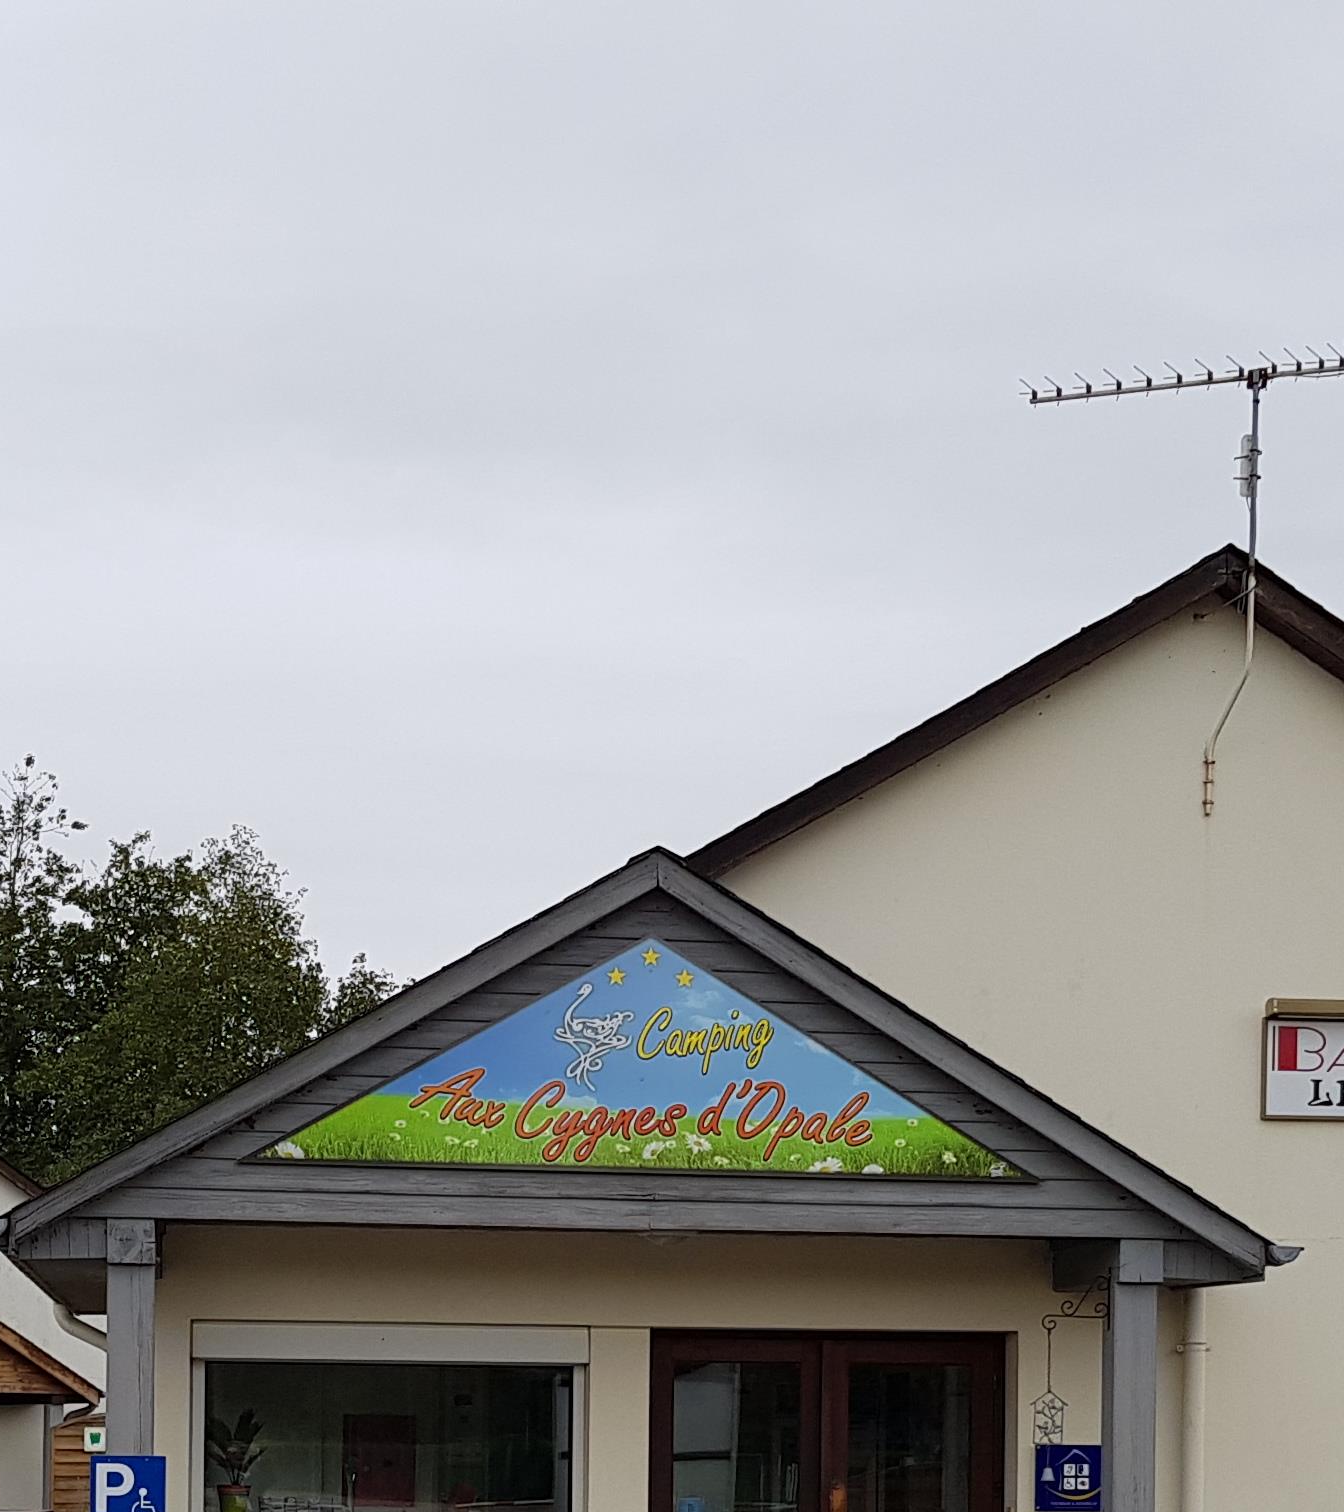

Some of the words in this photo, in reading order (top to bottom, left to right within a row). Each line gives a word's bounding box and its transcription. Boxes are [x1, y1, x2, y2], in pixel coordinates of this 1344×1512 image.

[636, 1006, 774, 1075] Camping
[409, 1066, 506, 1129] Aux
[514, 1079, 687, 1163] Cygnes
[696, 1077, 874, 1163] d'Opale
[95, 1462, 135, 1512] P
